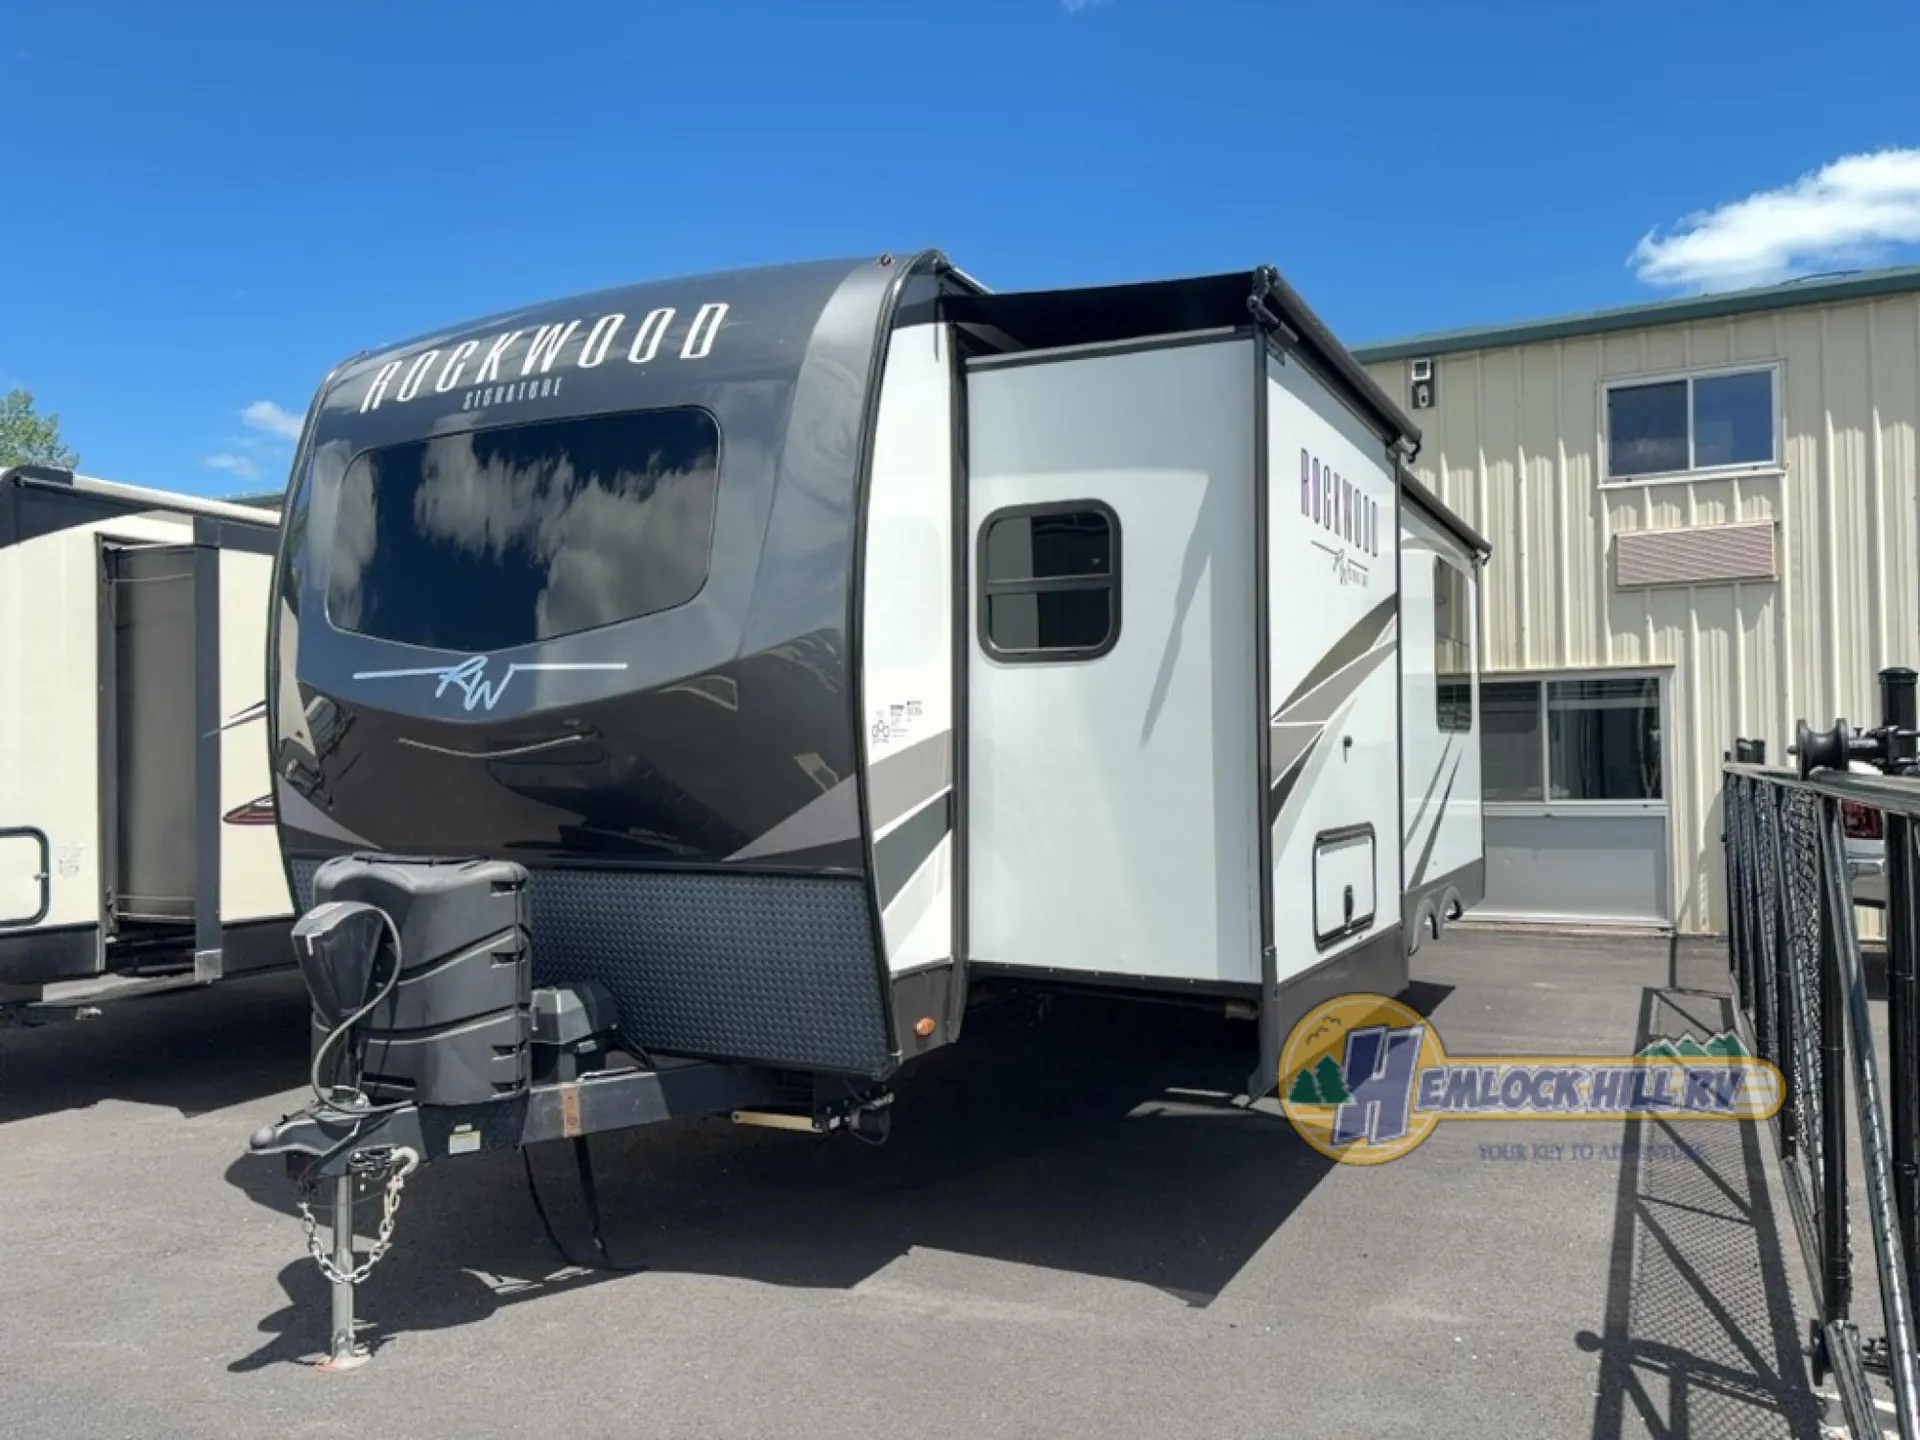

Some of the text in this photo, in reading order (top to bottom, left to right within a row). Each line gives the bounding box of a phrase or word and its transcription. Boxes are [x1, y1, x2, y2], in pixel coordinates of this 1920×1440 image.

[360, 303, 729, 414] ROCKWOOD
[462, 376, 563, 412] SIGNATURE
[1301, 447, 1379, 558] ROCKWOOD
